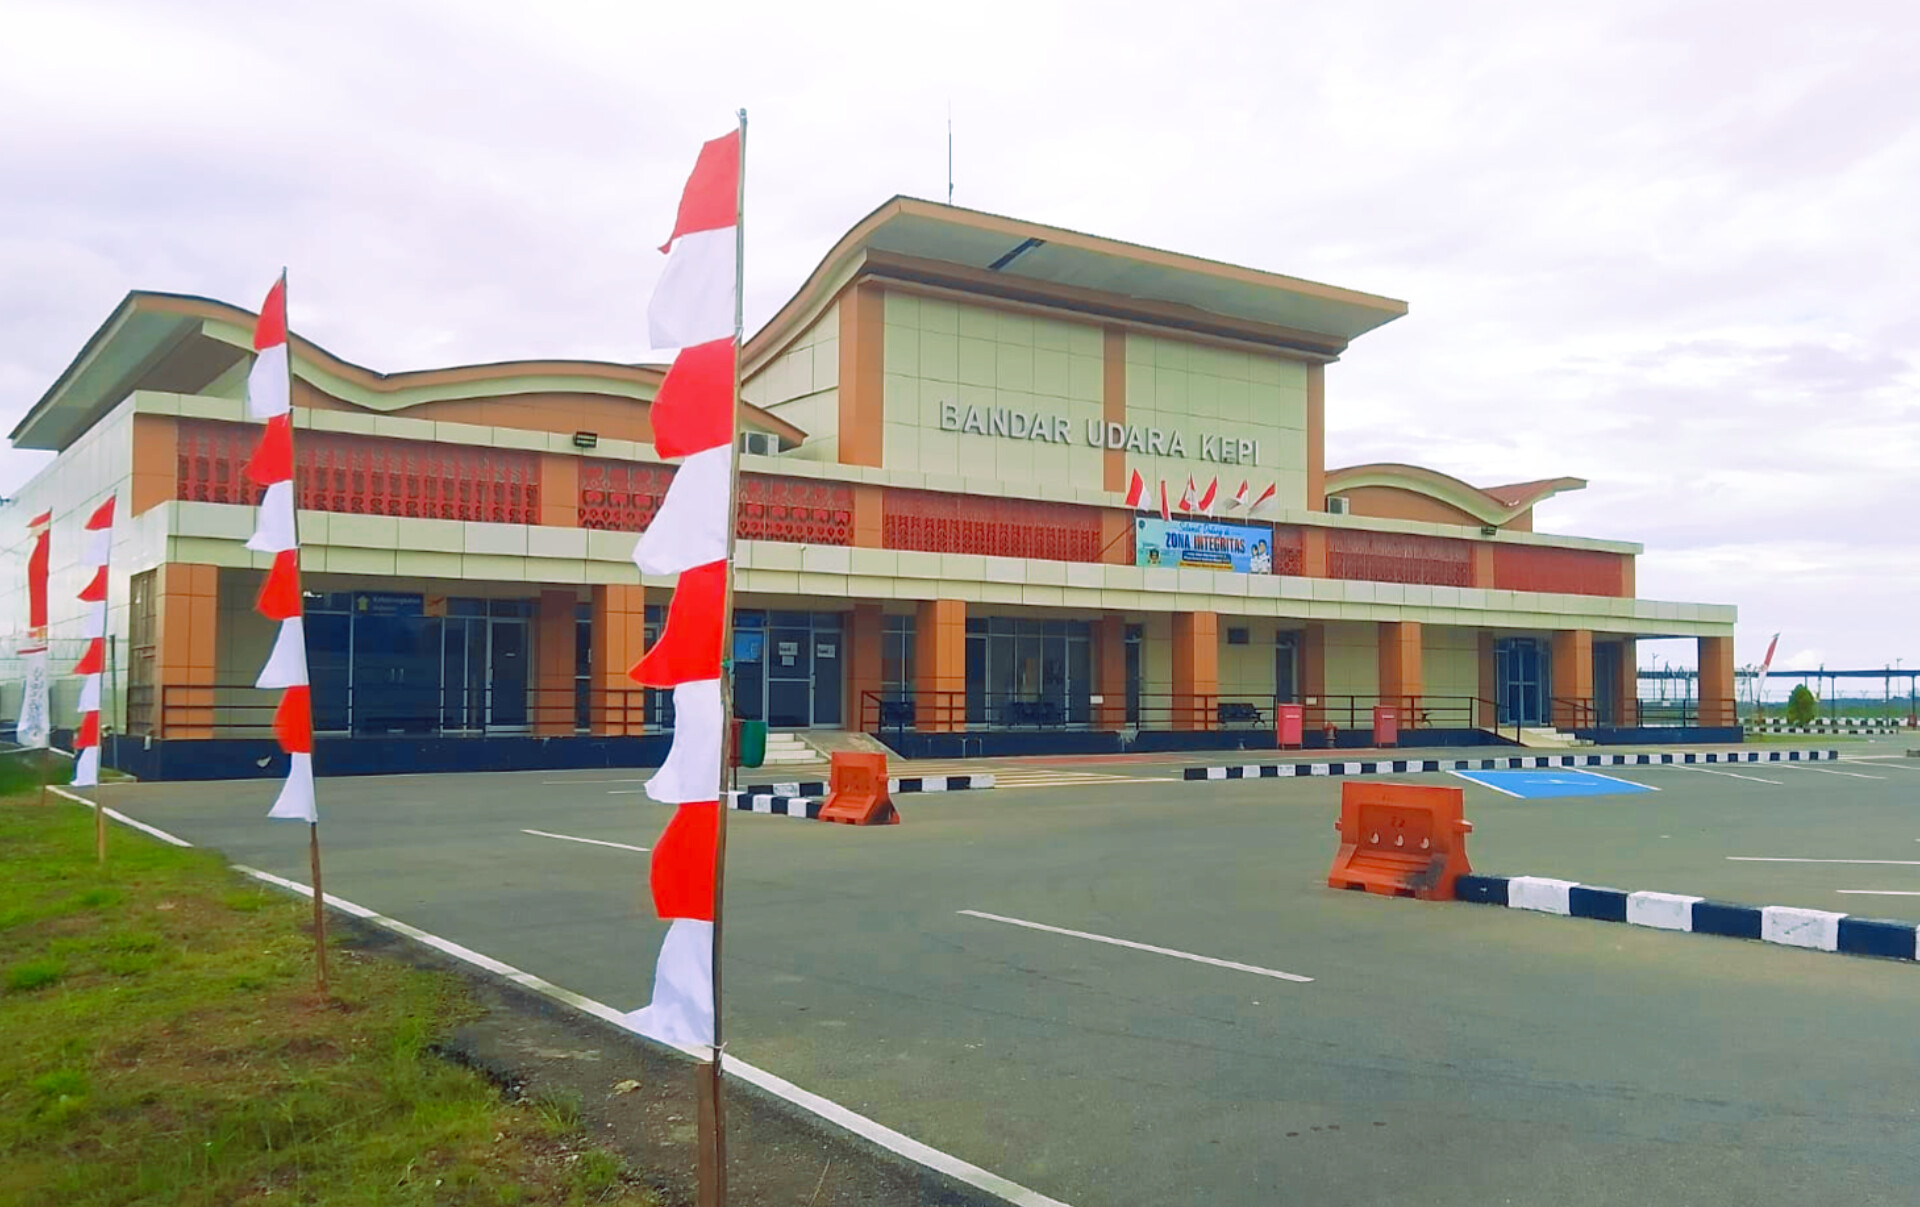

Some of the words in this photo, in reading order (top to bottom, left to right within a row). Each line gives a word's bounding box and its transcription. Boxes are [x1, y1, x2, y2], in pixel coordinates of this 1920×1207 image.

[941, 402, 1072, 444] BANDAR
[1086, 418, 1186, 457] UDARA
[1200, 433, 1259, 466] KEPI
[1166, 532, 1190, 549] ZONA
[1194, 535, 1245, 553] INTEGRITAS
